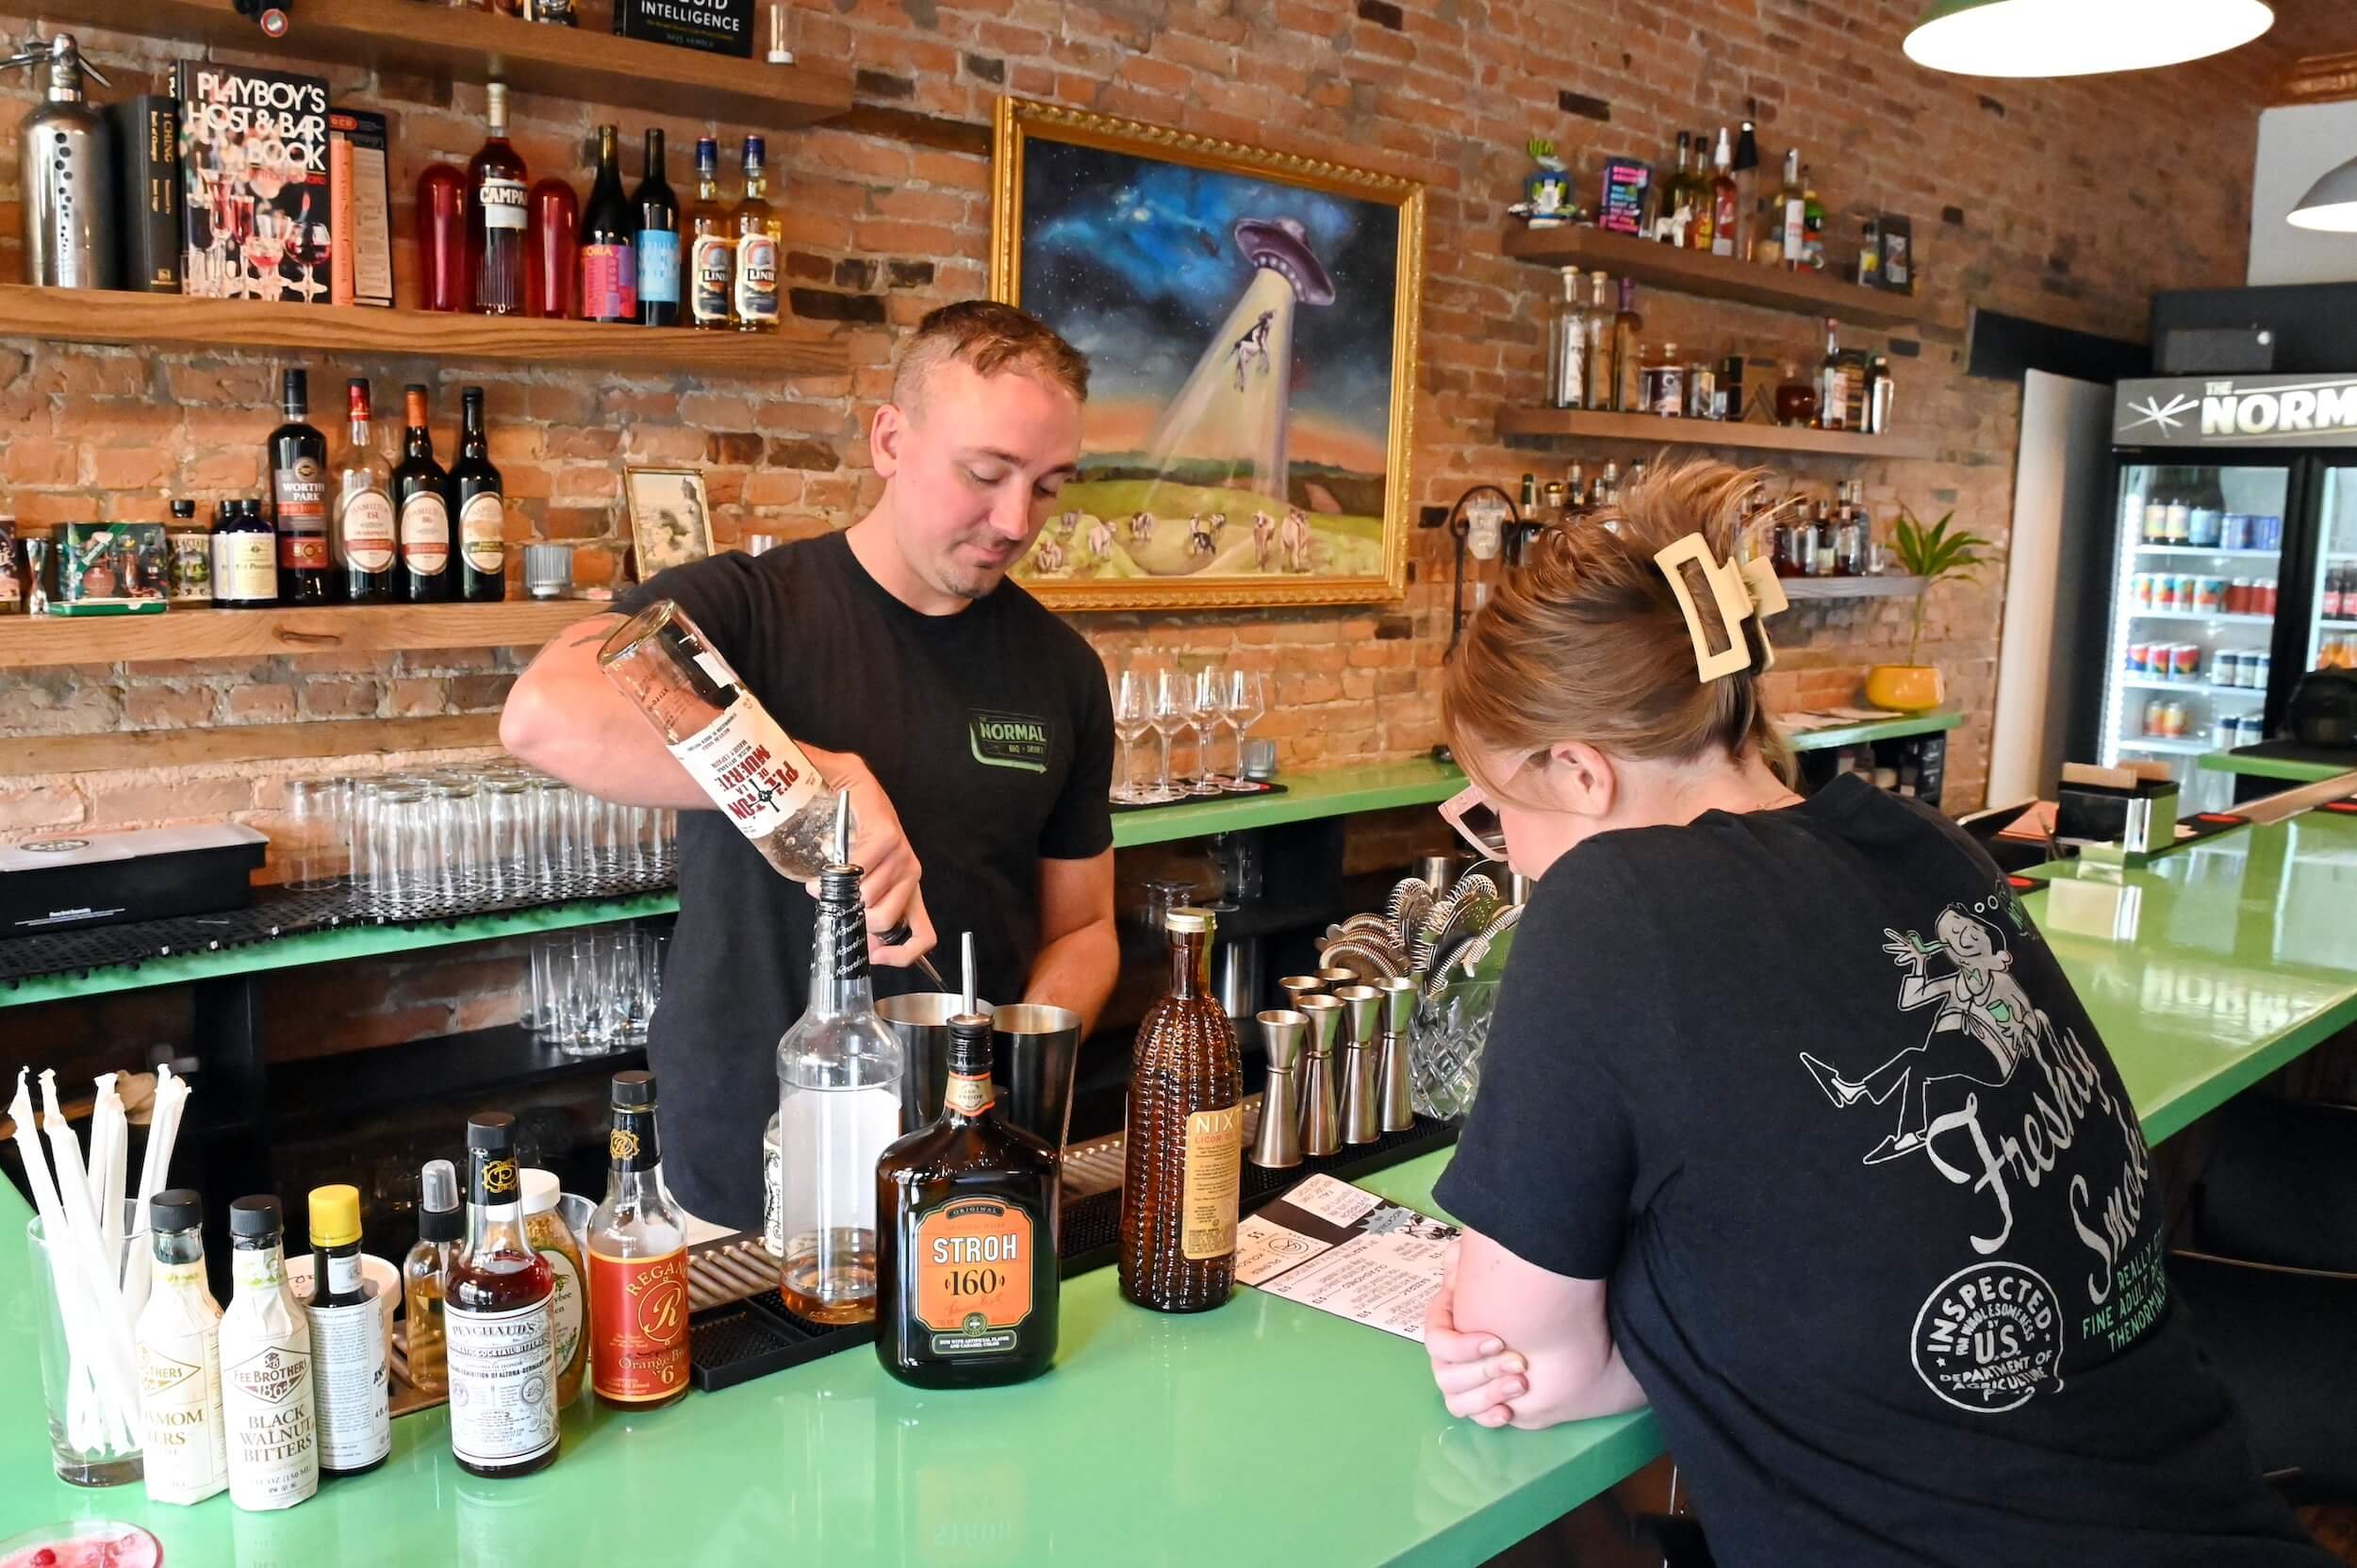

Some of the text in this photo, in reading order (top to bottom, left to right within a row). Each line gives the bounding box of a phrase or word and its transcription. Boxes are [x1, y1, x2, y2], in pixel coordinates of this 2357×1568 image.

[640, 1, 740, 32] INTELLIGENCE
[197, 72, 326, 114] PLAYBOY'S
[188, 101, 252, 133] HOST
[279, 111, 326, 142] BAR
[246, 137, 326, 172] BOOK
[2205, 381, 2233, 396] THE
[2201, 386, 2357, 435] NORM
[293, 492, 320, 502] PARK
[980, 722, 1047, 742] NORMAL
[715, 745, 771, 792] MUERTE
[1195, 1134, 1222, 1145] LICOR
[952, 1206, 997, 1216] ORIGINAL
[932, 1233, 1017, 1263] STROH
[950, 1268, 997, 1296] 160
[2117, 1242, 2151, 1292] REALLY
[1927, 1276, 2052, 1352] INSPECTED
[2082, 1274, 2149, 1340] FINE ADULT
[1961, 1303, 2035, 1342] WHOLESOMENESS
[1974, 1324, 2021, 1364] U.S.
[618, 1356, 670, 1370] Orange
[1939, 1350, 2052, 1382] DEPARTMENT OF
[1953, 1366, 2049, 1391] AGRICULTURE
[239, 1416, 312, 1445] WALNUT
[249, 1404, 305, 1428] BLACK
[243, 1432, 313, 1462] BITTERS
